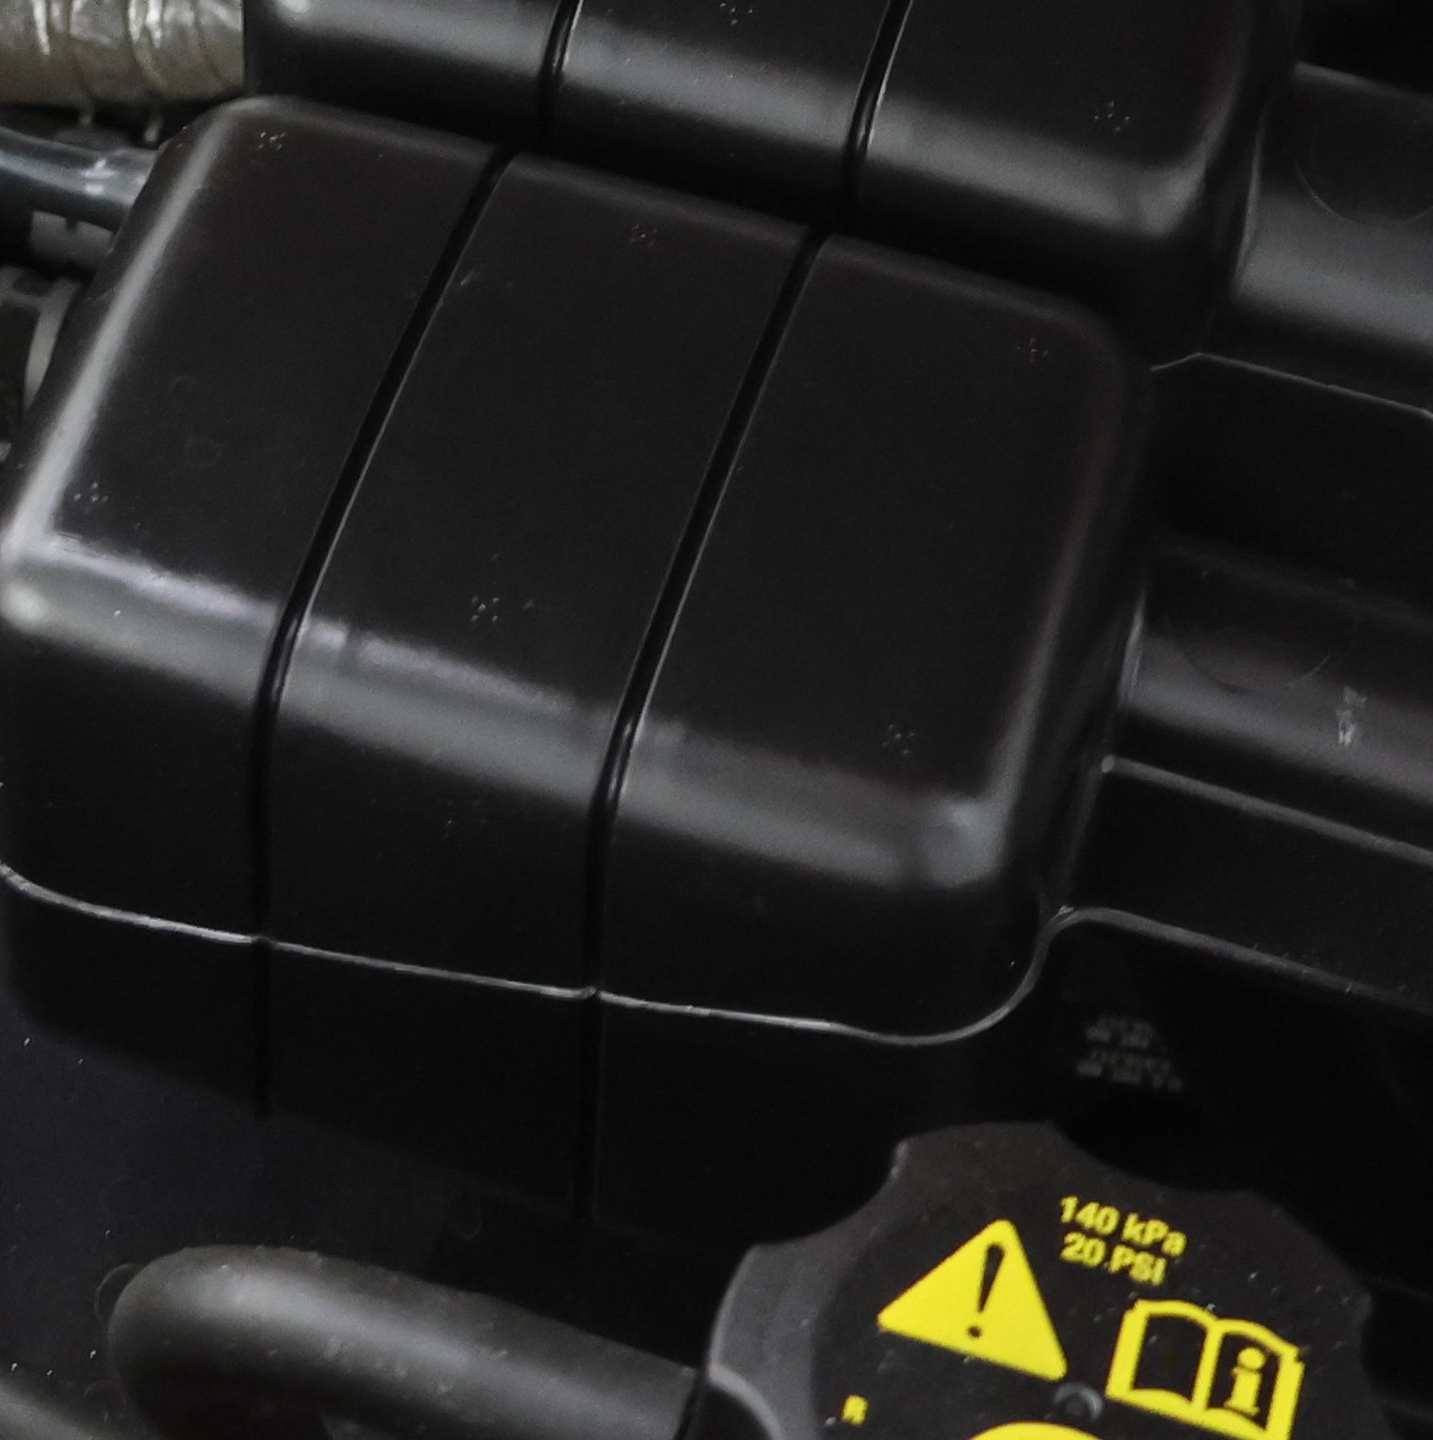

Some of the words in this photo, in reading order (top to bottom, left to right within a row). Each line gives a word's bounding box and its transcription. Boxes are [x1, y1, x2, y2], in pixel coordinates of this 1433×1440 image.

[1060, 1194, 1121, 1237] 140
[1121, 1212, 1187, 1257] kPa
[1059, 1231, 1107, 1268] 20
[1107, 1244, 1167, 1287] PSI
